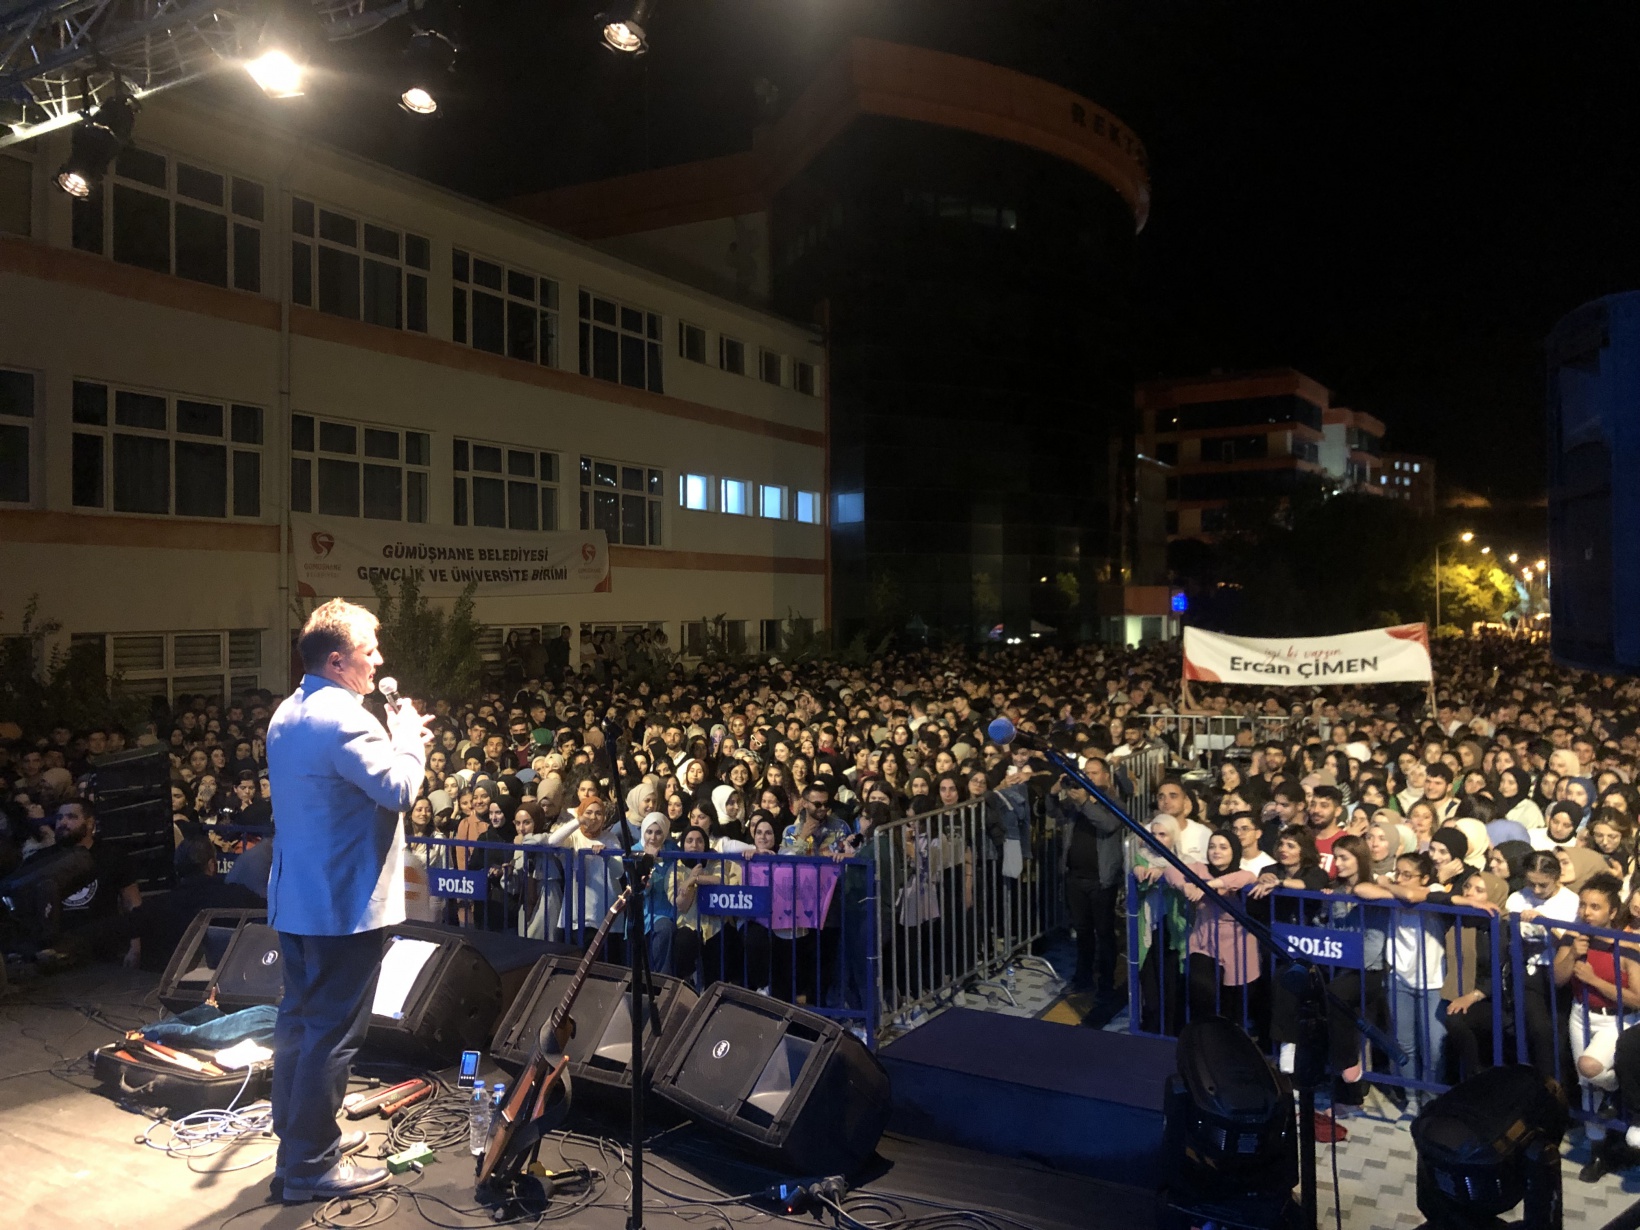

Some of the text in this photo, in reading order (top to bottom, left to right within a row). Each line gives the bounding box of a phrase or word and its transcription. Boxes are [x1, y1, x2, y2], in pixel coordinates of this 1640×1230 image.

[382, 542, 549, 564] GÜMÜŞHANE BELEDİYESİ
[357, 565, 426, 585] GENÇLİK
[429, 569, 448, 582] VE
[451, 566, 529, 582] ÜNİVERSİTE
[531, 565, 568, 581] BİRİMİ
[1230, 656, 1379, 679] Ercan ÇİMEN
[438, 876, 474, 894] POLİS
[709, 890, 753, 910] POLİS
